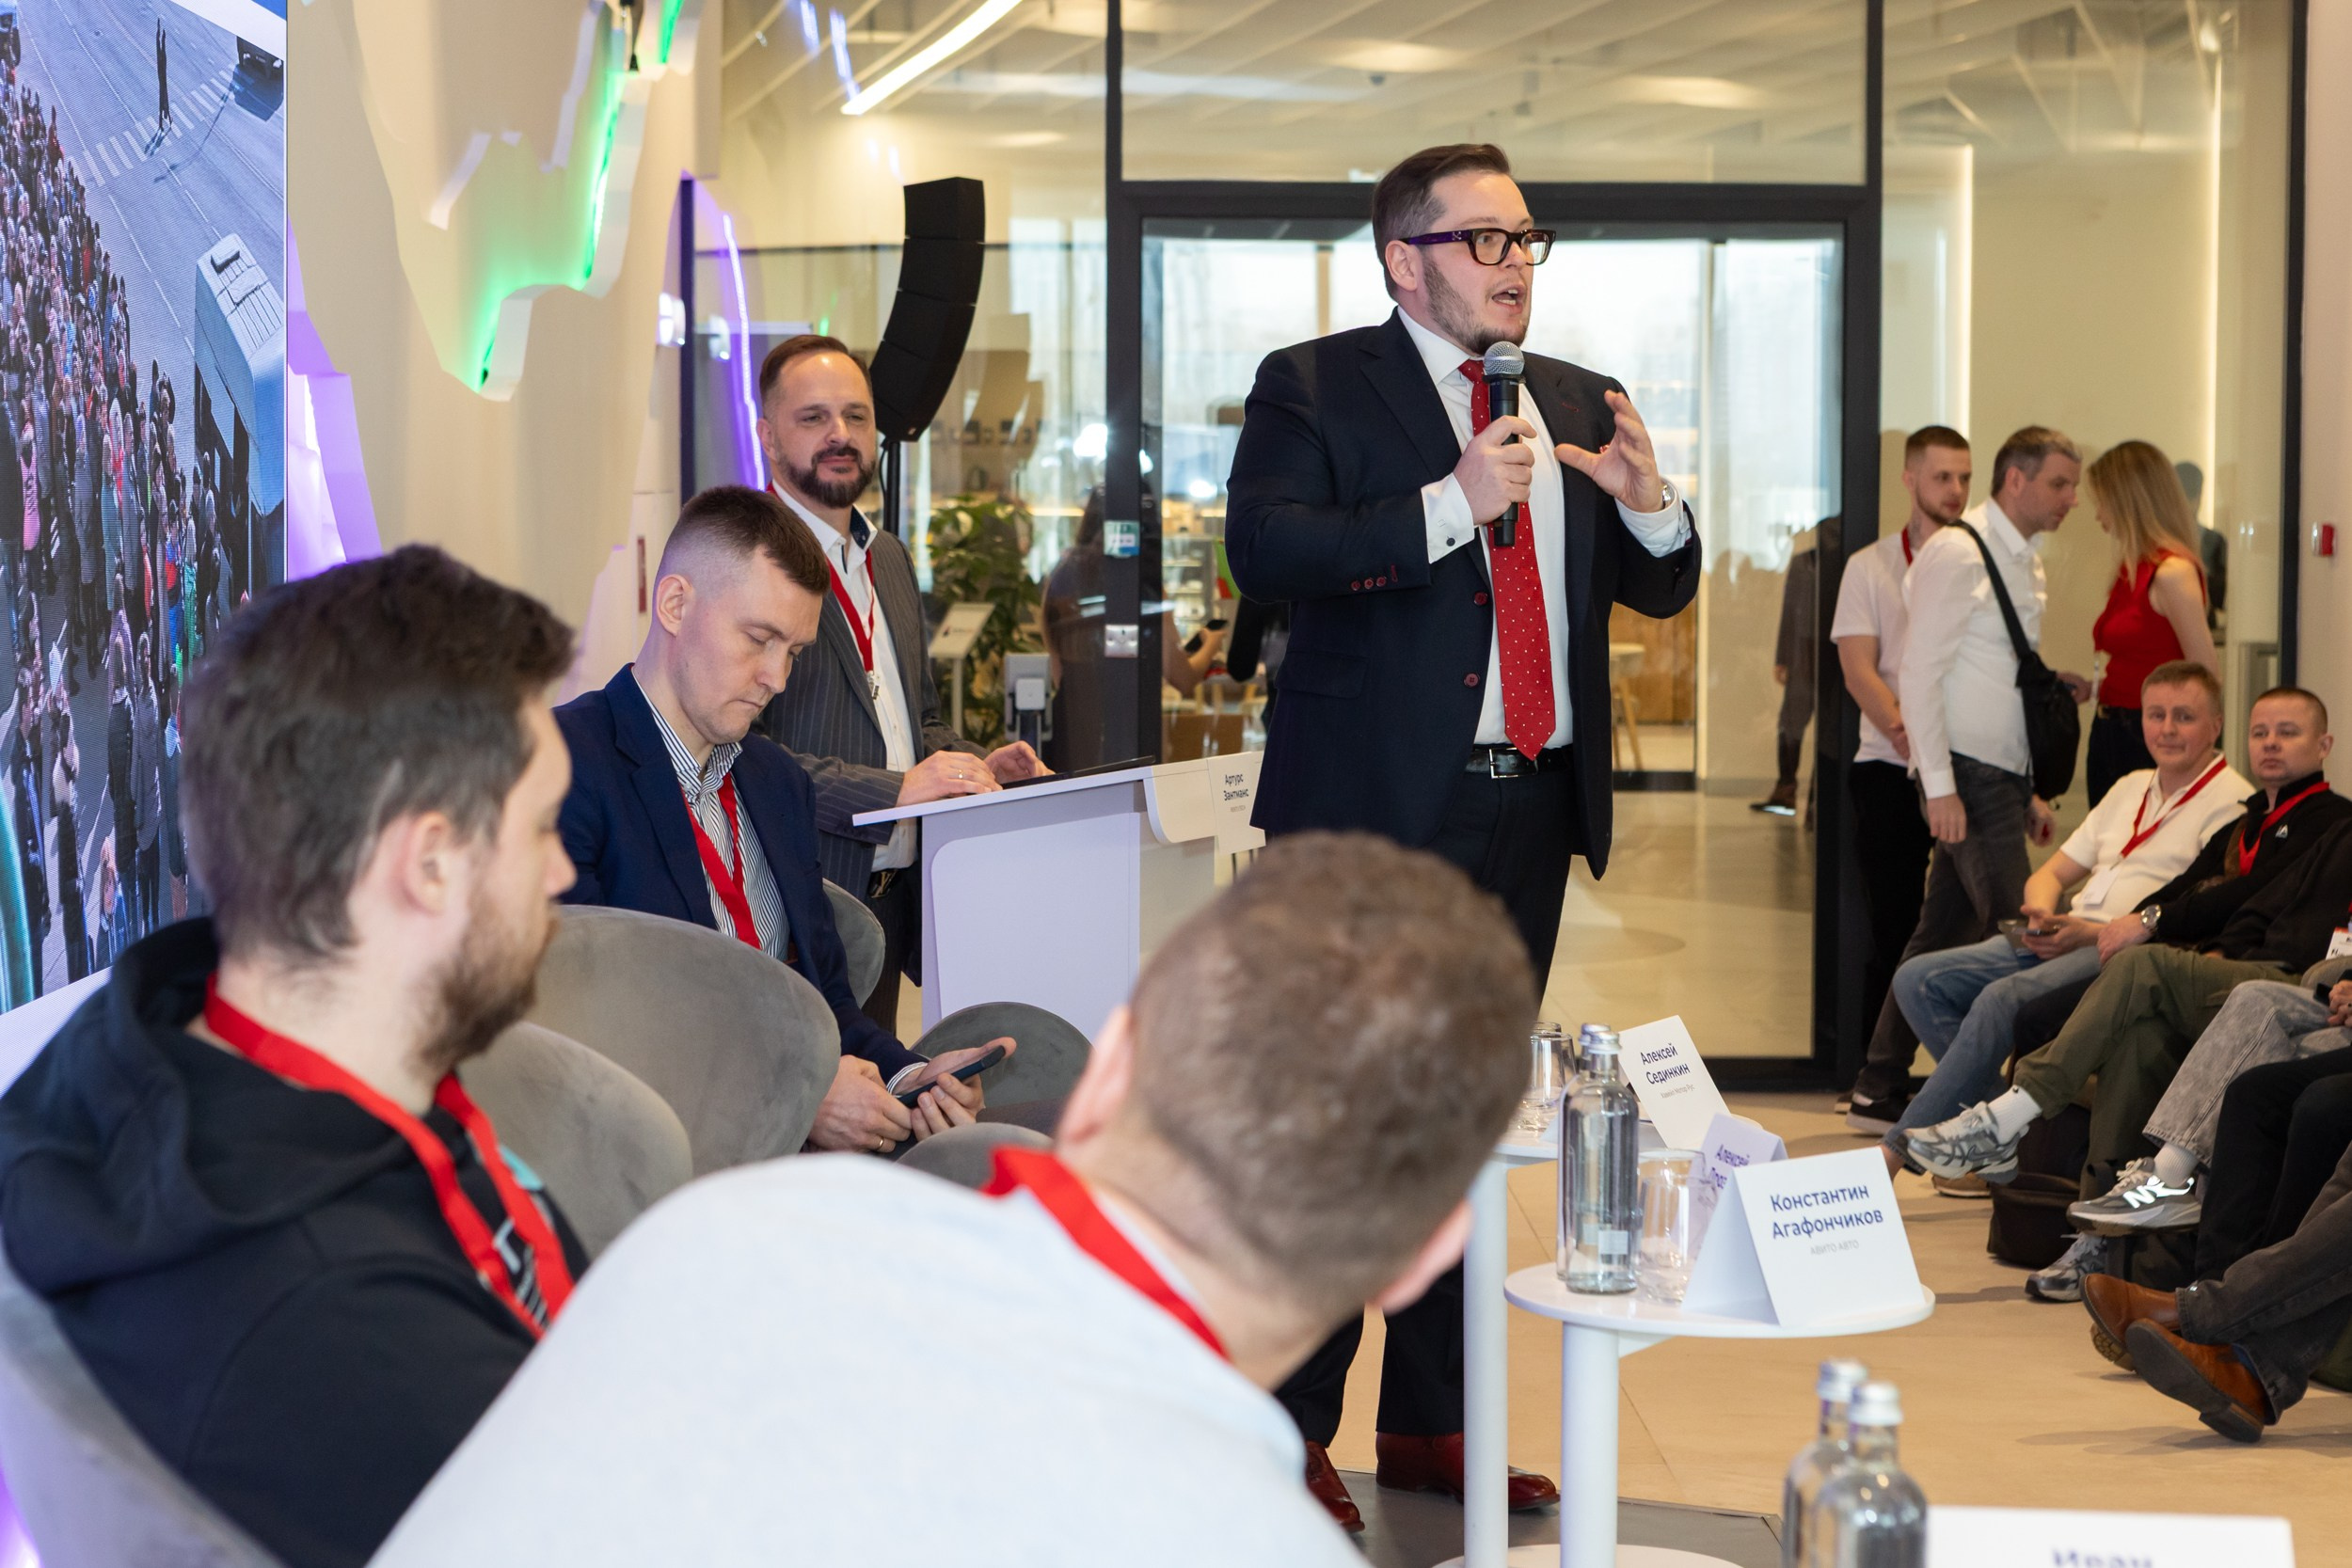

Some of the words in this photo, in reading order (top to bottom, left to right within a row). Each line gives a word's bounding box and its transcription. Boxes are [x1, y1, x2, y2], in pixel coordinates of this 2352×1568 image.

[1225, 774, 1244, 787] Артурс
[1640, 1042, 1678, 1065] Алексей
[1645, 1063, 1691, 1085] Сединкин
[1770, 1184, 1870, 1212] Константин
[1772, 1210, 1884, 1240] Агафончиков
